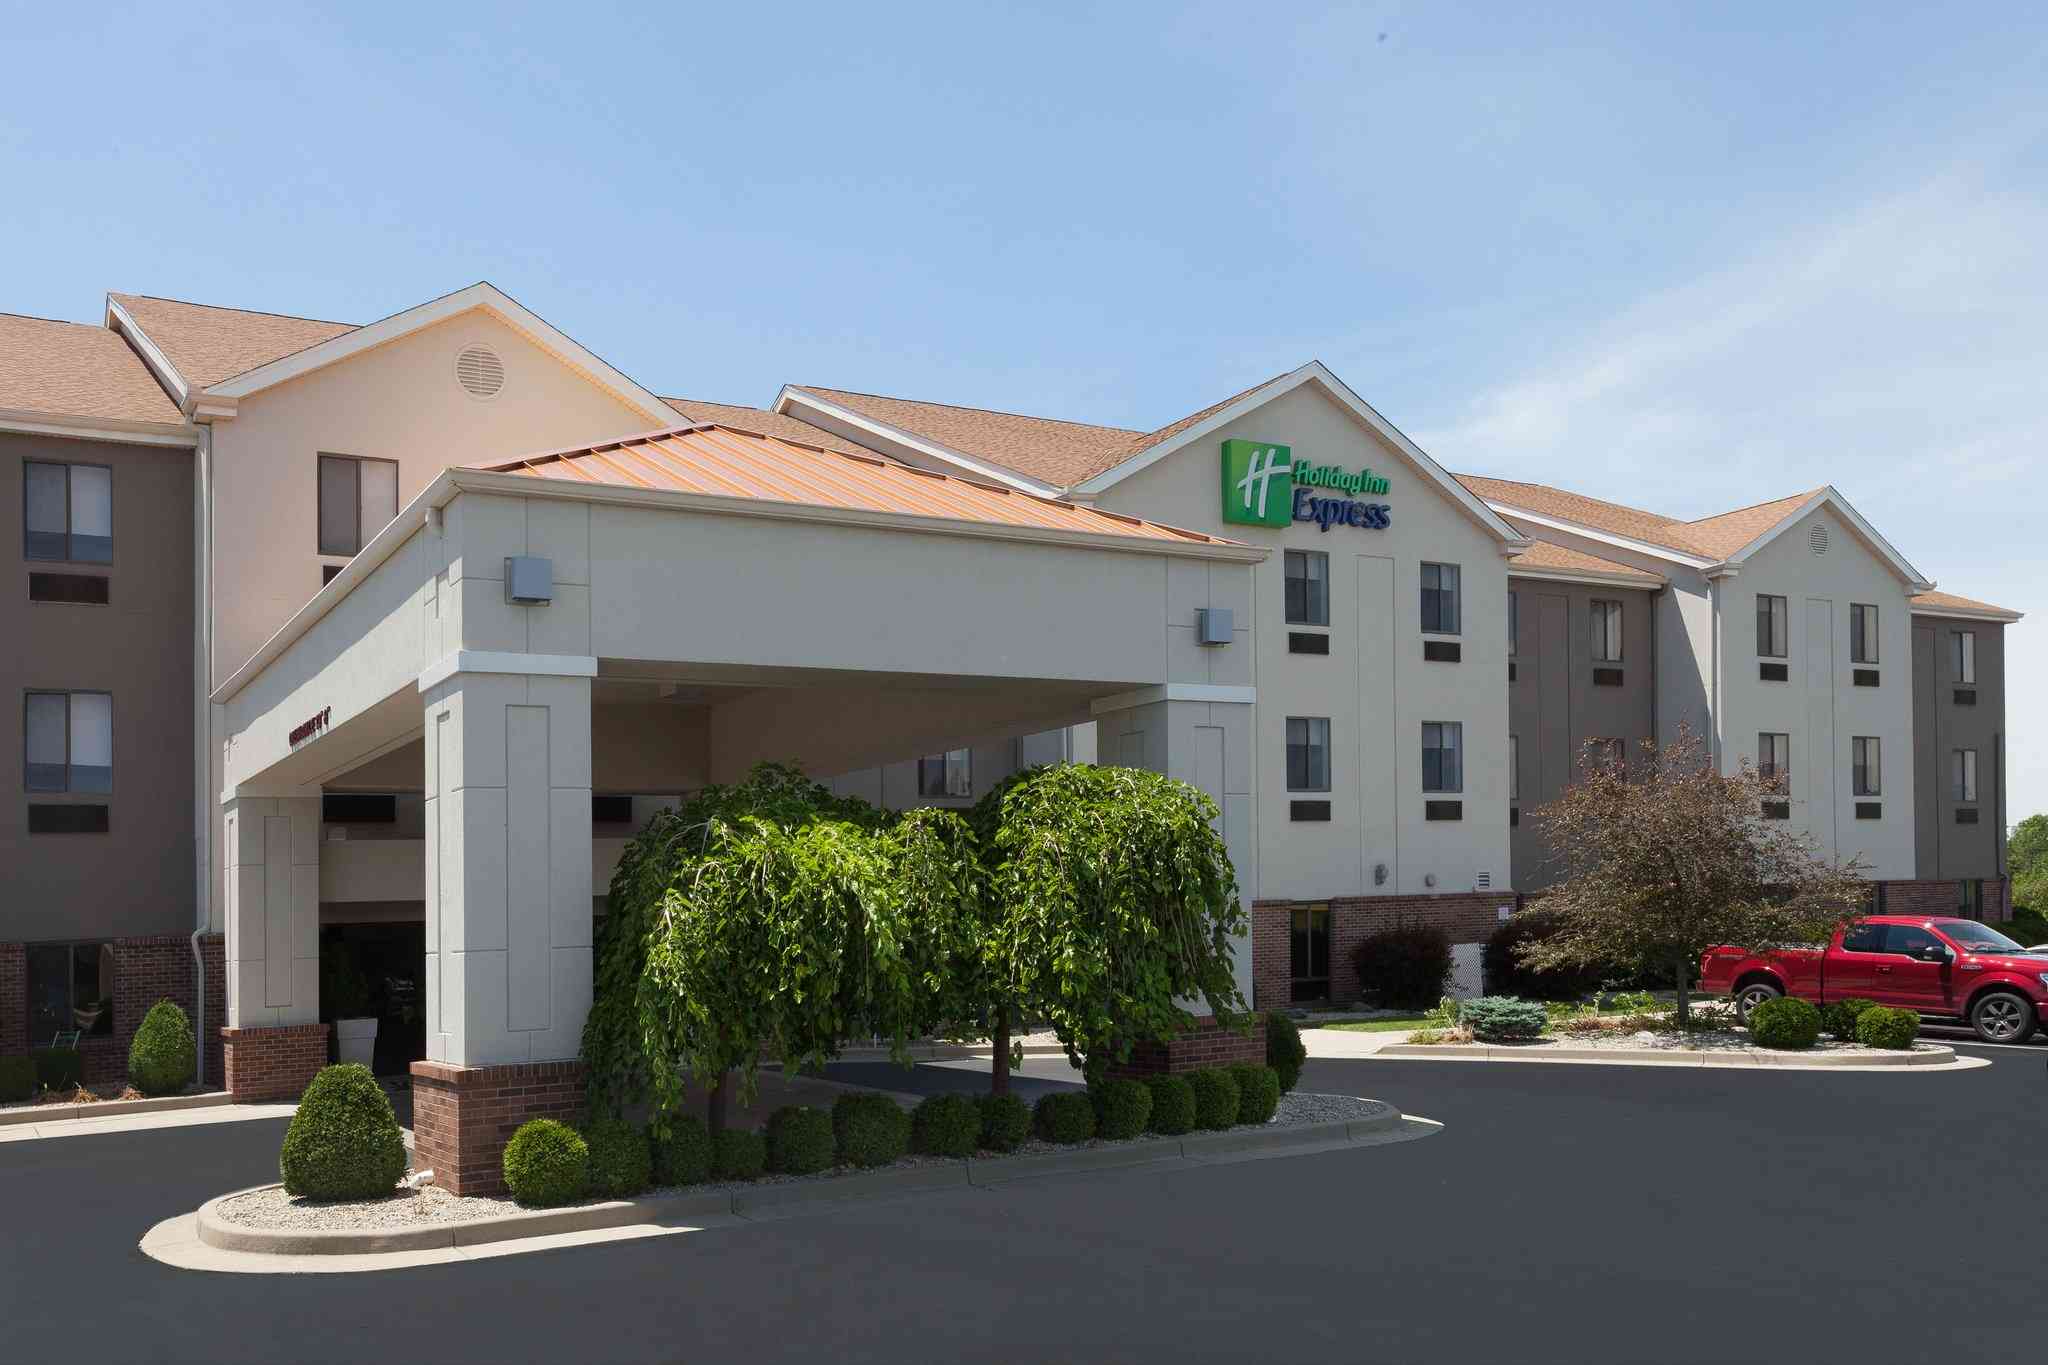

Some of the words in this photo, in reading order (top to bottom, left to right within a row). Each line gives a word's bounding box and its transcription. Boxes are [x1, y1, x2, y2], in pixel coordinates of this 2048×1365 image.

[1293, 459, 1363, 496] Holiday
[1361, 469, 1391, 496] Inn
[1292, 487, 1391, 532] Express
